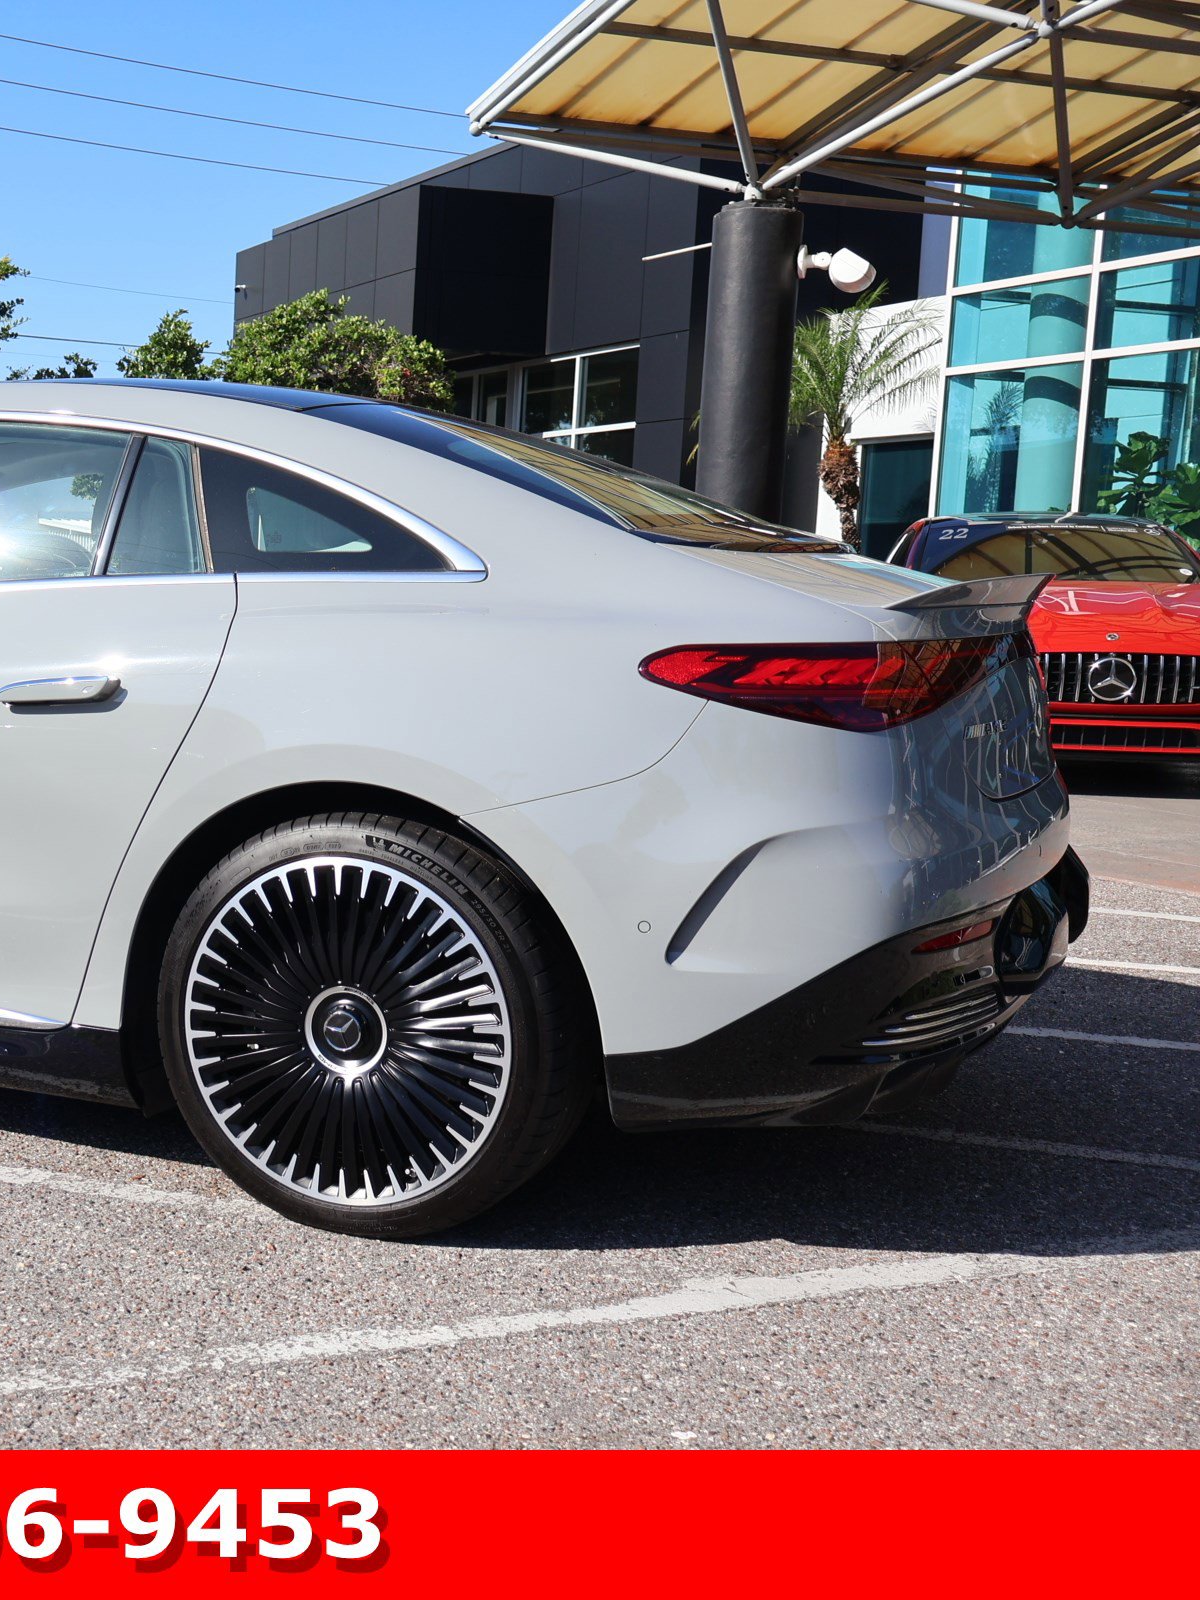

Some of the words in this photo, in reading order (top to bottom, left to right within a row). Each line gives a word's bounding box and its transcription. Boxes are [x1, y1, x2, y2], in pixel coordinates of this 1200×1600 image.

[939, 528, 969, 540] 22
[389, 843, 469, 895] MICHELIN
[471, 899, 497, 928] 295/30
